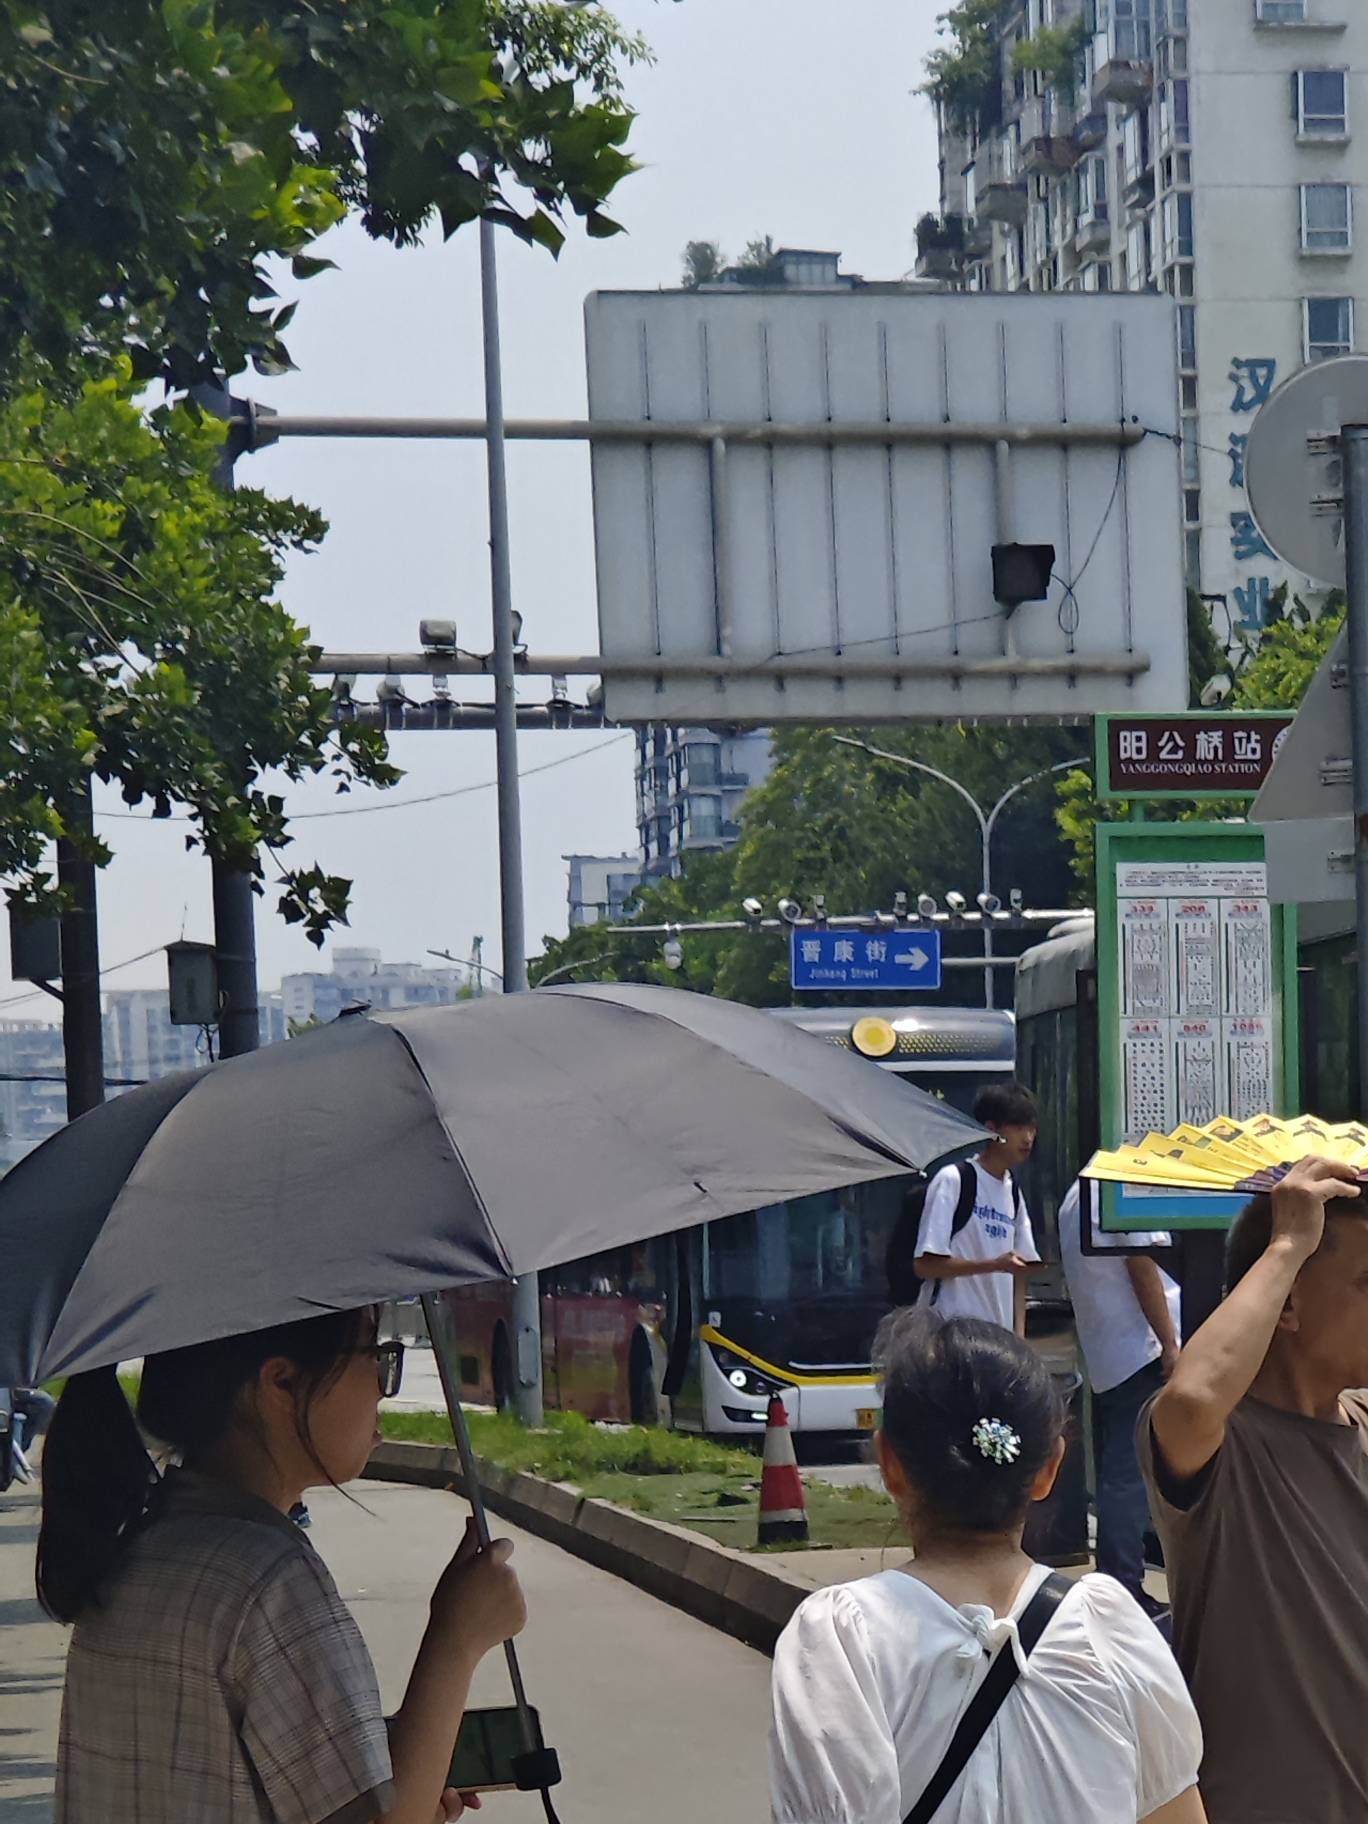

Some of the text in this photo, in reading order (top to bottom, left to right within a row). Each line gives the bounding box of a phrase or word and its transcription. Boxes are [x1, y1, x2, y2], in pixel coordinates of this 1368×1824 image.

[1119, 730, 1262, 761] 阳公桥站
[1120, 762, 1262, 776] YANGGONGQIAO STATION
[851, 967, 879, 979] Street
